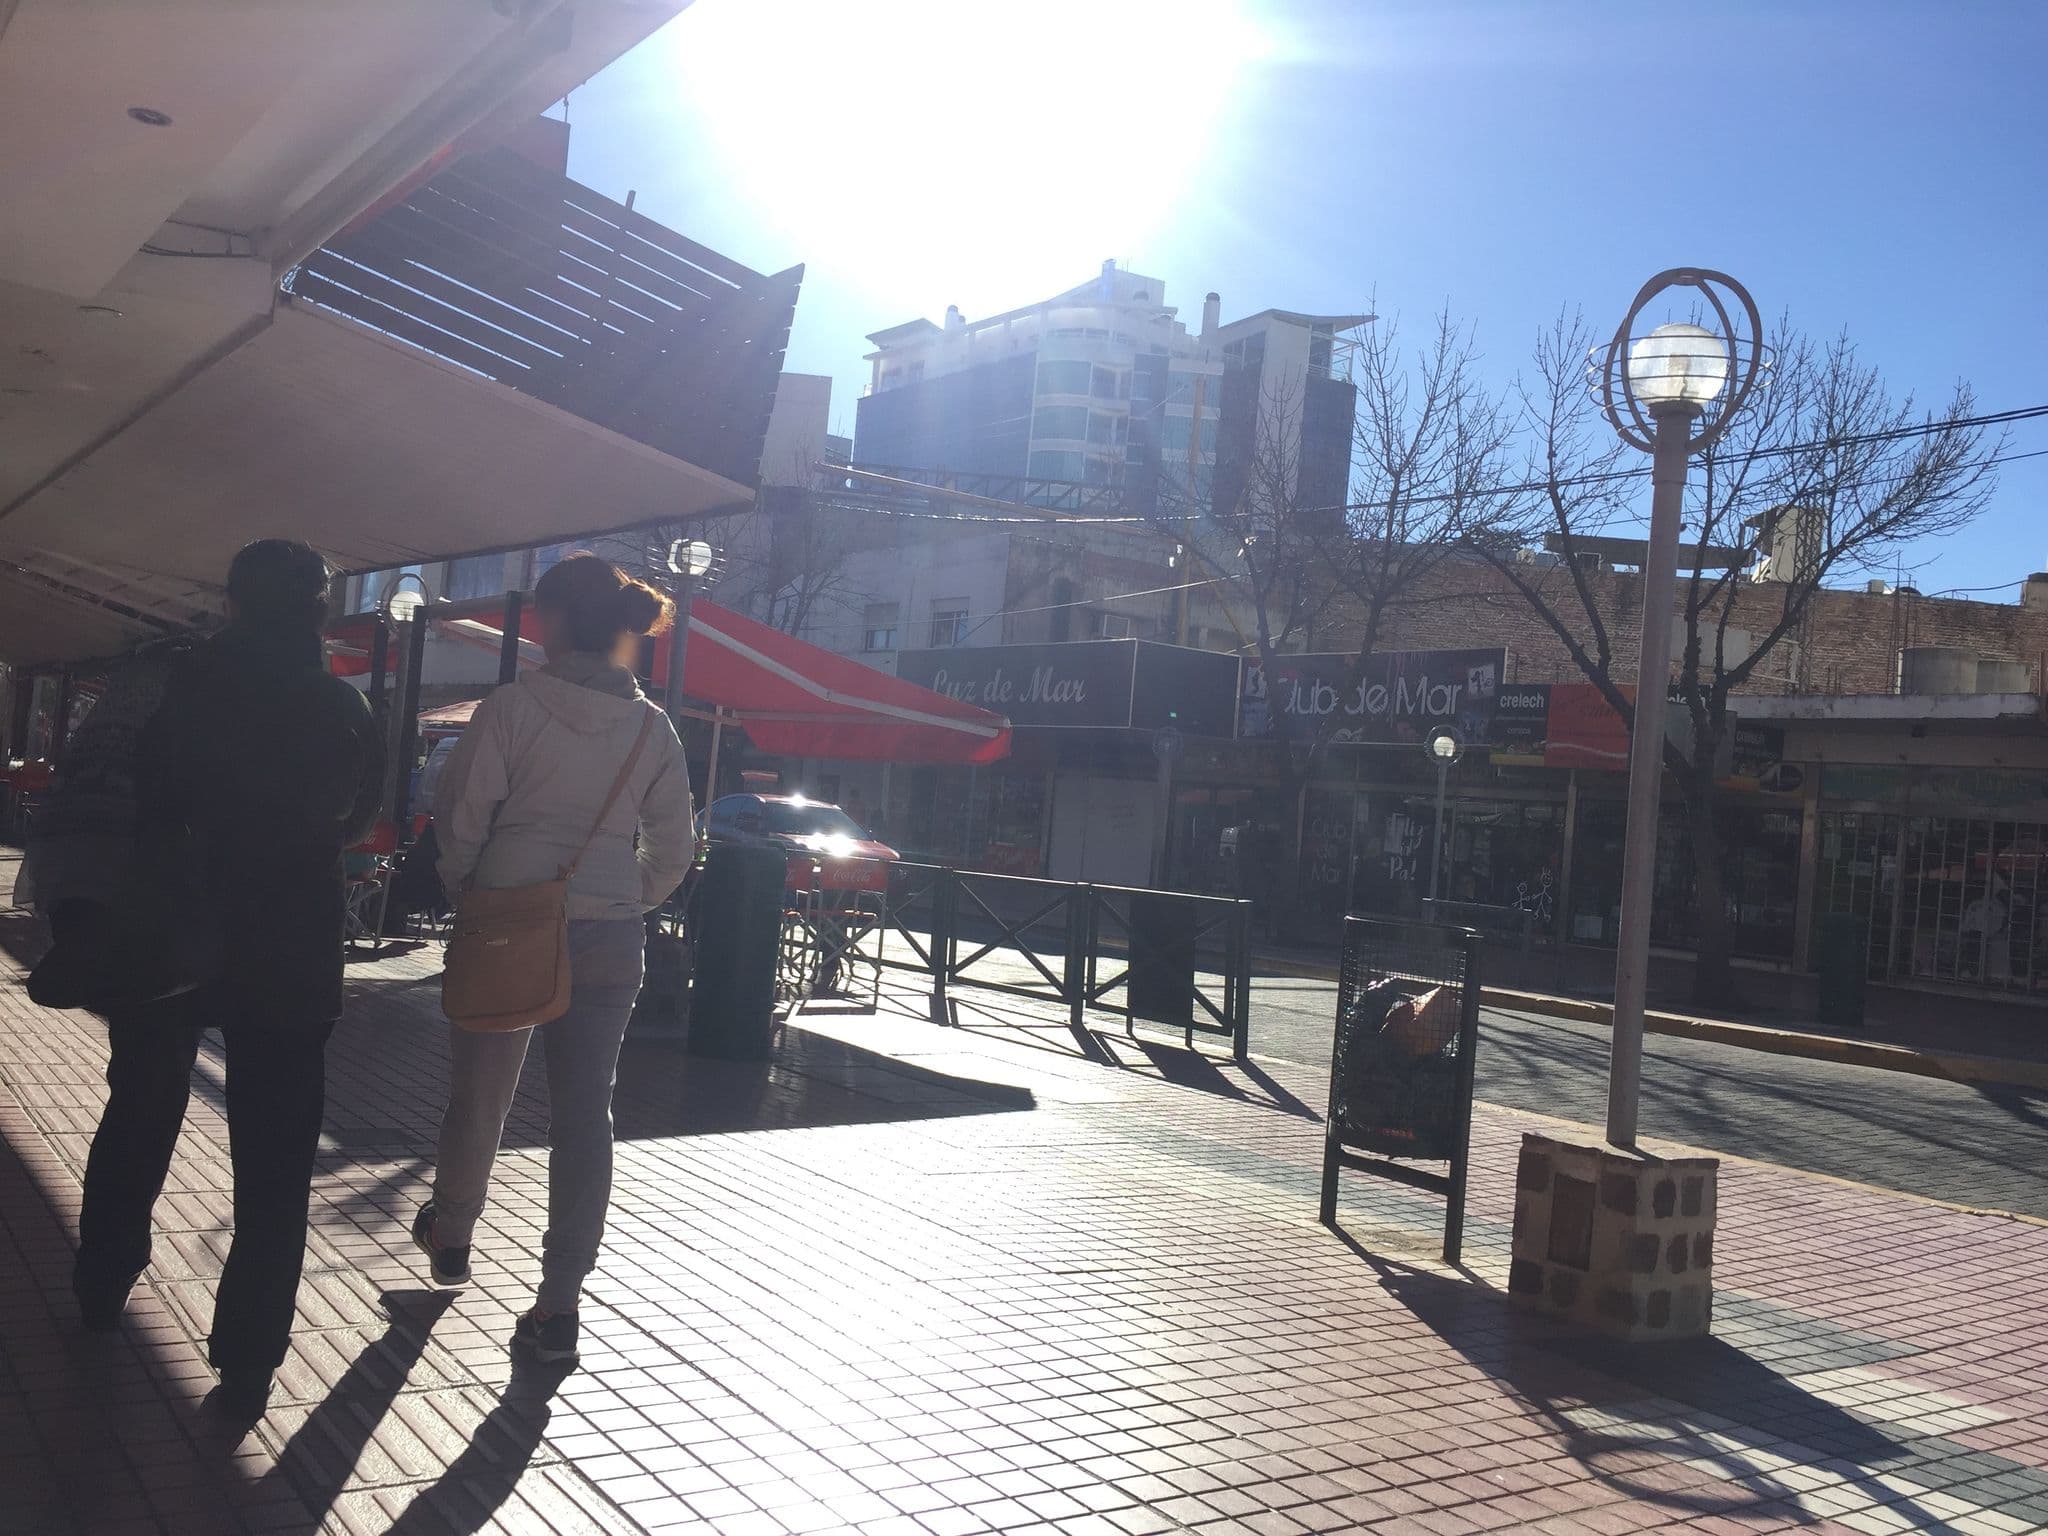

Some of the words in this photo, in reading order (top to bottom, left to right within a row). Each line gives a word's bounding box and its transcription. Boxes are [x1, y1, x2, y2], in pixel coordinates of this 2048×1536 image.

[982, 667, 1014, 704] de
[1018, 664, 1090, 705] Mar
[1395, 675, 1463, 716] Mar
[1499, 692, 1545, 708] crelech
